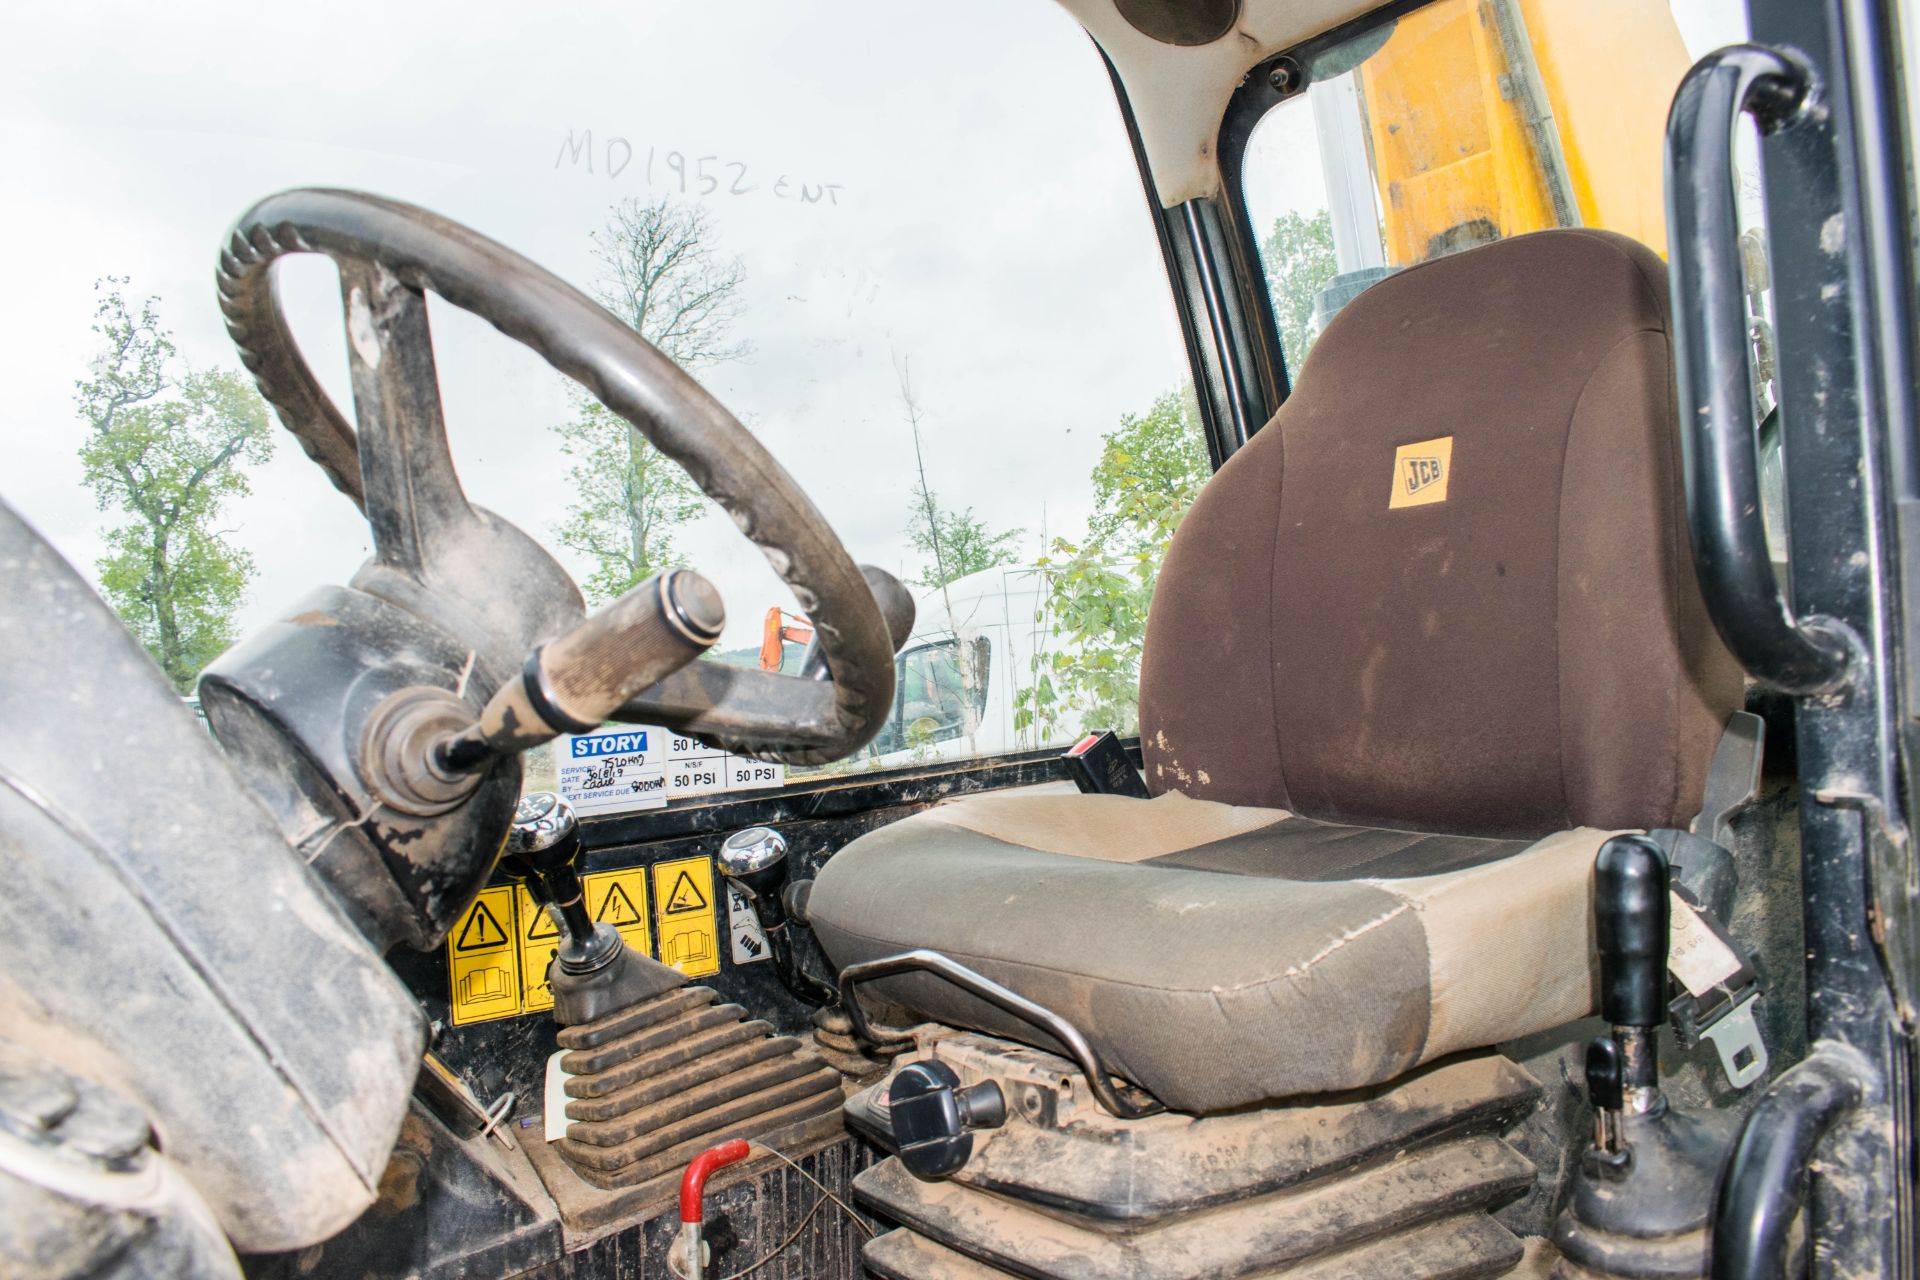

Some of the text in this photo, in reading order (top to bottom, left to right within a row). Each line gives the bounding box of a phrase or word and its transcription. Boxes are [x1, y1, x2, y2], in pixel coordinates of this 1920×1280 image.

[1408, 460, 1440, 490] JCB
[574, 734, 644, 756] STORY
[673, 739, 688, 752] 50
[561, 765, 597, 775] SERVICED
[685, 761, 703, 769] N/S/F
[561, 775, 580, 783] DATE
[674, 772, 716, 788] 50 PSI
[736, 768, 775, 782] 50 PSI
[567, 793, 581, 801] EXT
[583, 789, 614, 800] SERVICE
[615, 787, 631, 796] DUE
